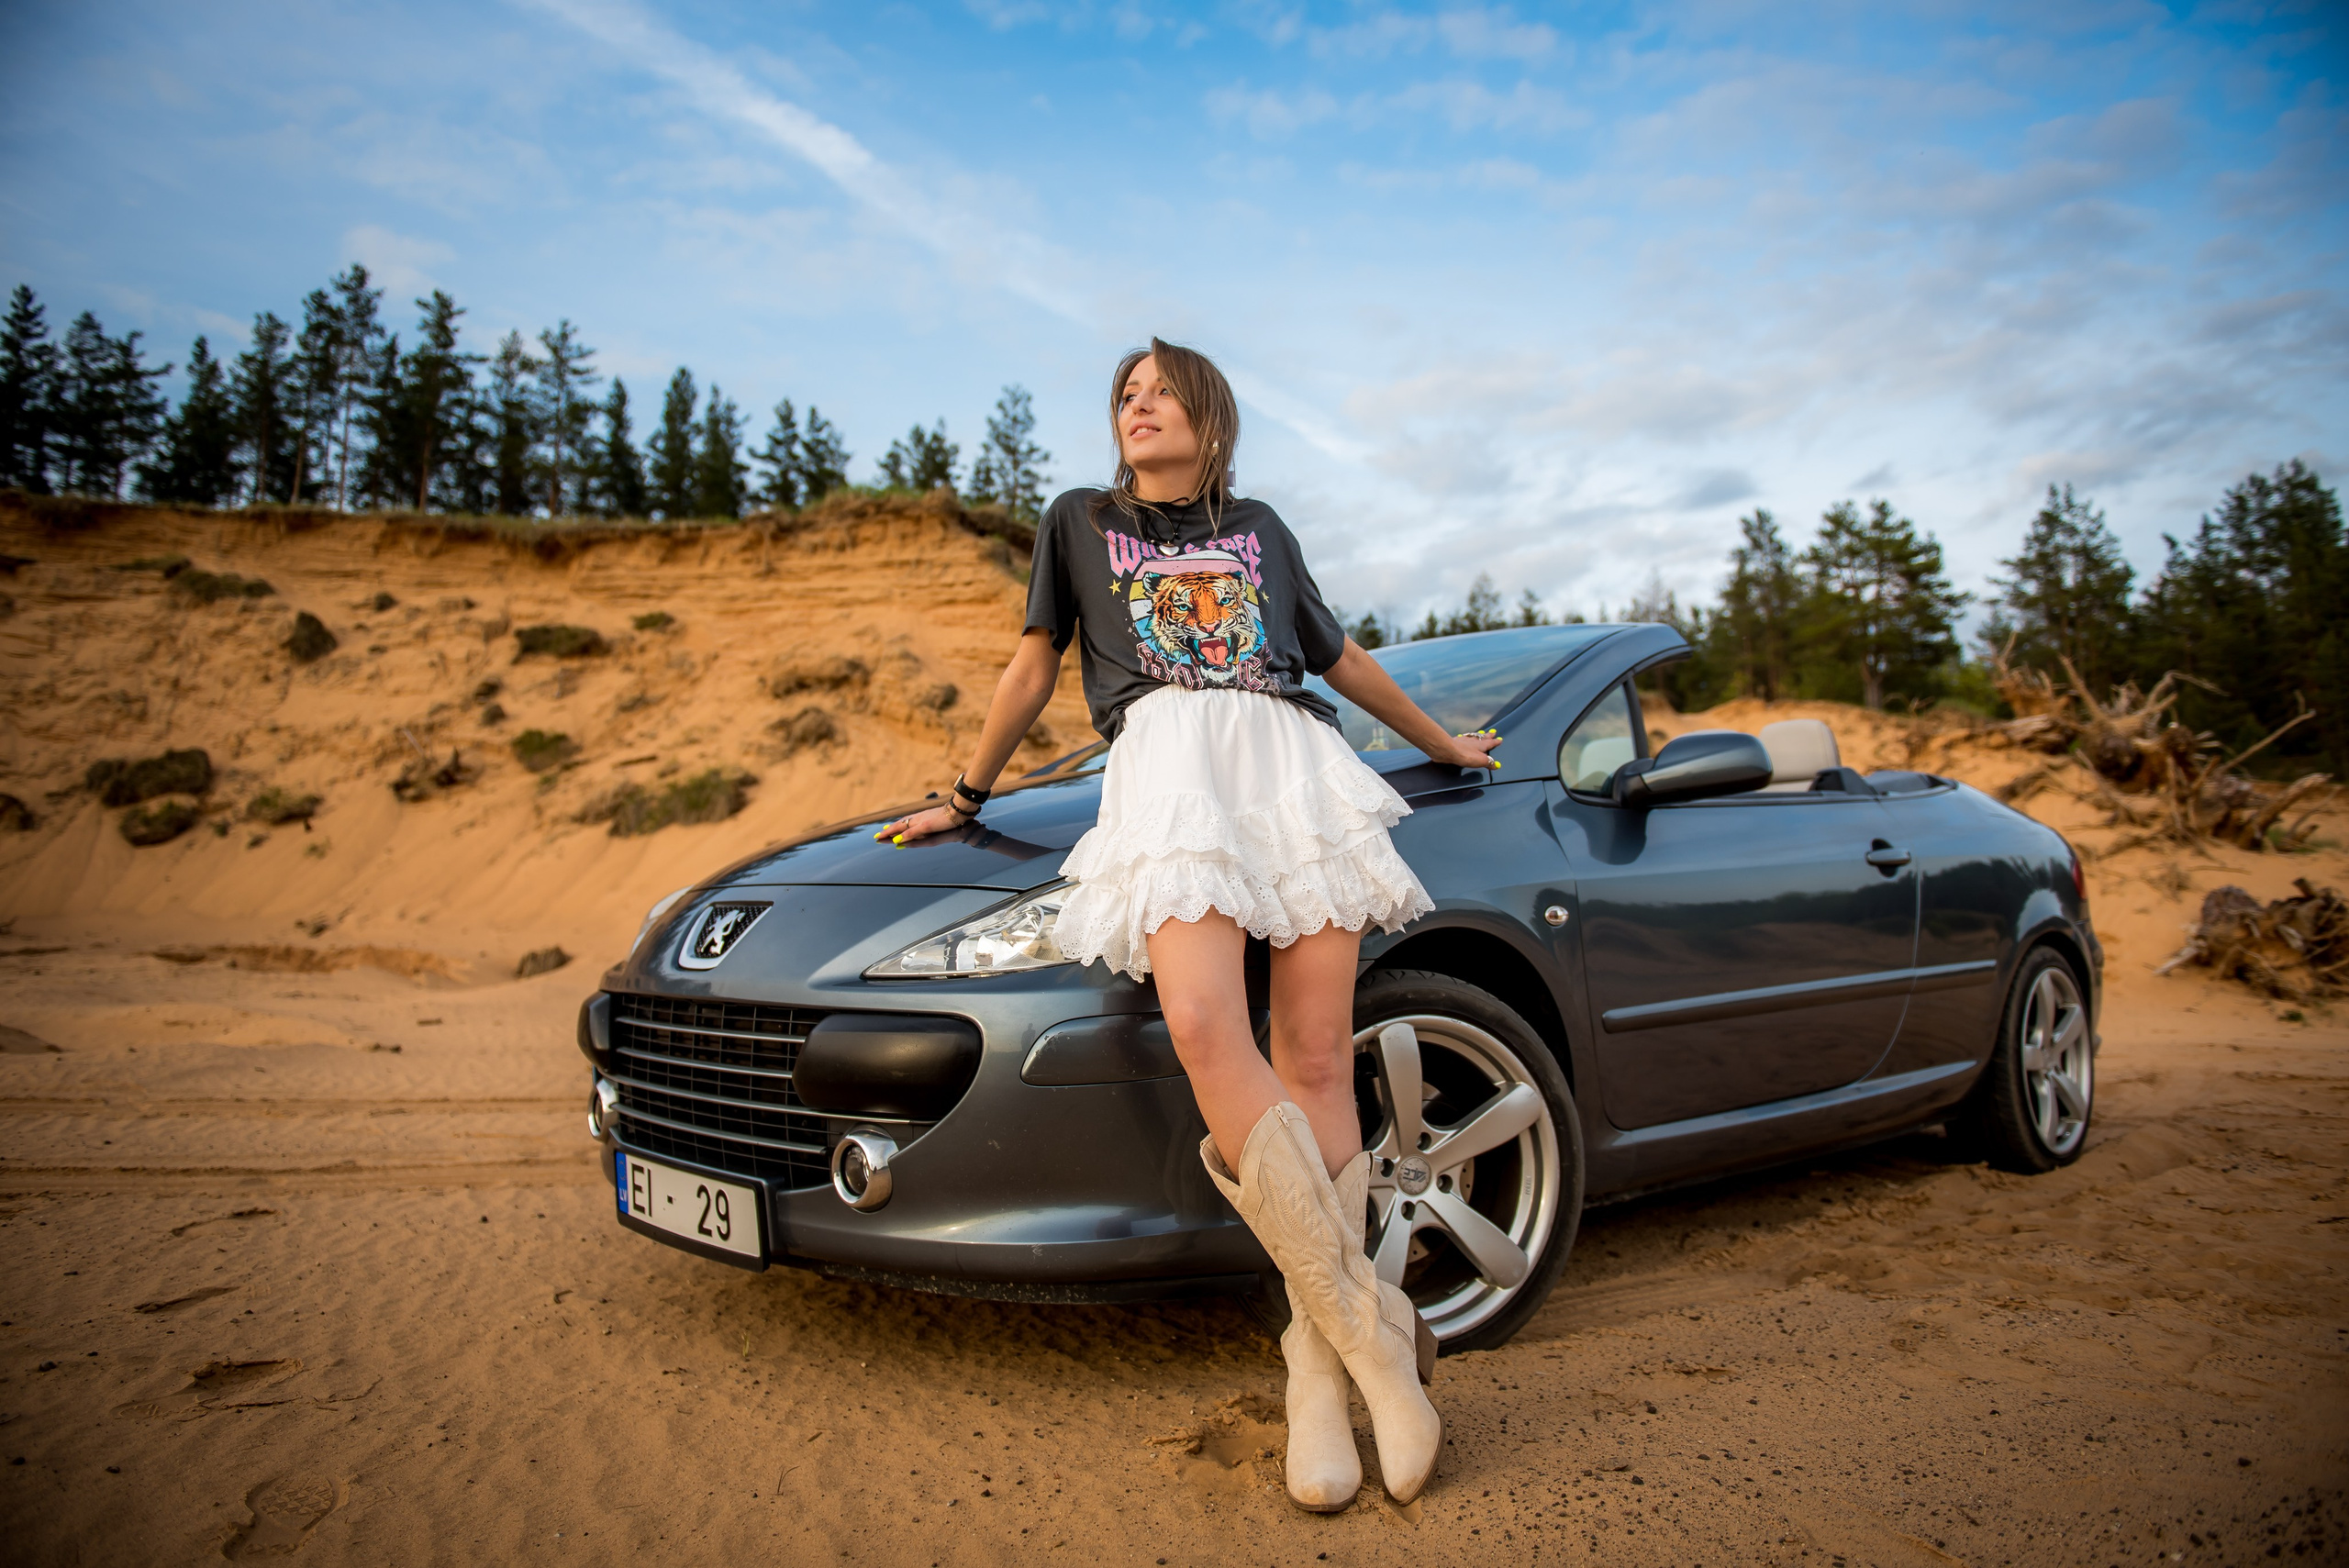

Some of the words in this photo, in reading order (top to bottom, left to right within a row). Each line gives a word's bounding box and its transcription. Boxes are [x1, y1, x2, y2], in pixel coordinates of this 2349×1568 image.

[1105, 528, 1178, 578] WIL
[618, 1187, 628, 1203] LV
[631, 1163, 652, 1218] EI
[696, 1184, 730, 1241] 29
